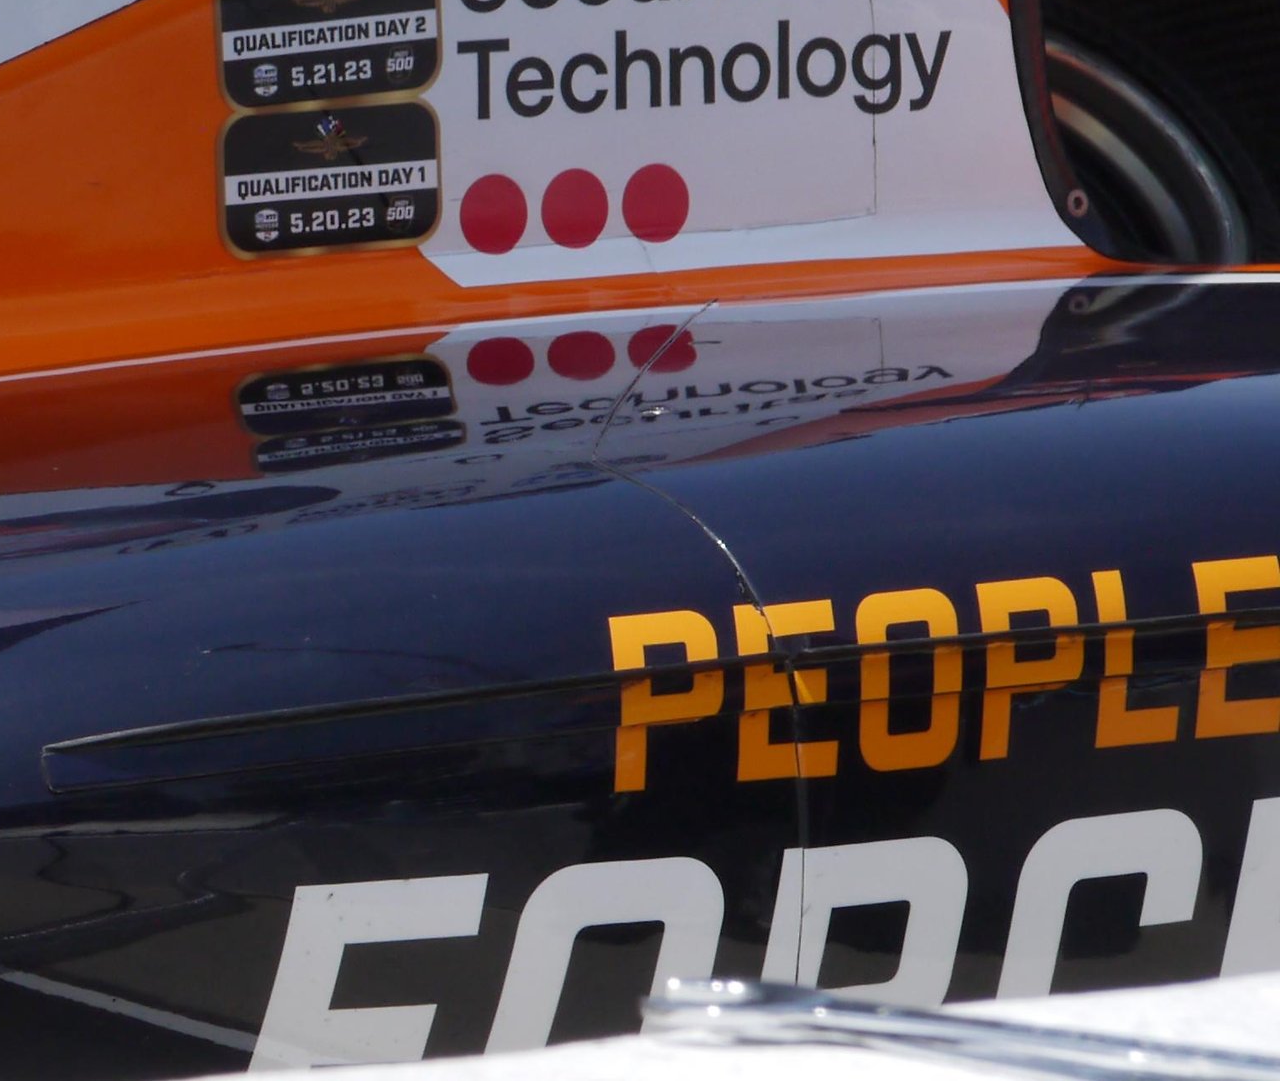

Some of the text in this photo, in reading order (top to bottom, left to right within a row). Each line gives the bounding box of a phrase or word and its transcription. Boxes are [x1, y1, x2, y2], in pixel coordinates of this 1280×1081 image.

[233, 16, 427, 56] QUALIFICATION DAY 2
[291, 59, 372, 87] 5.21.23
[386, 56, 415, 72] 500
[457, 19, 953, 120] Technology
[237, 166, 426, 200] QUALIFICATION DAY 1
[290, 207, 375, 234] 5.20.23
[386, 205, 415, 221] 500
[607, 555, 1280, 793] PEOPLE
